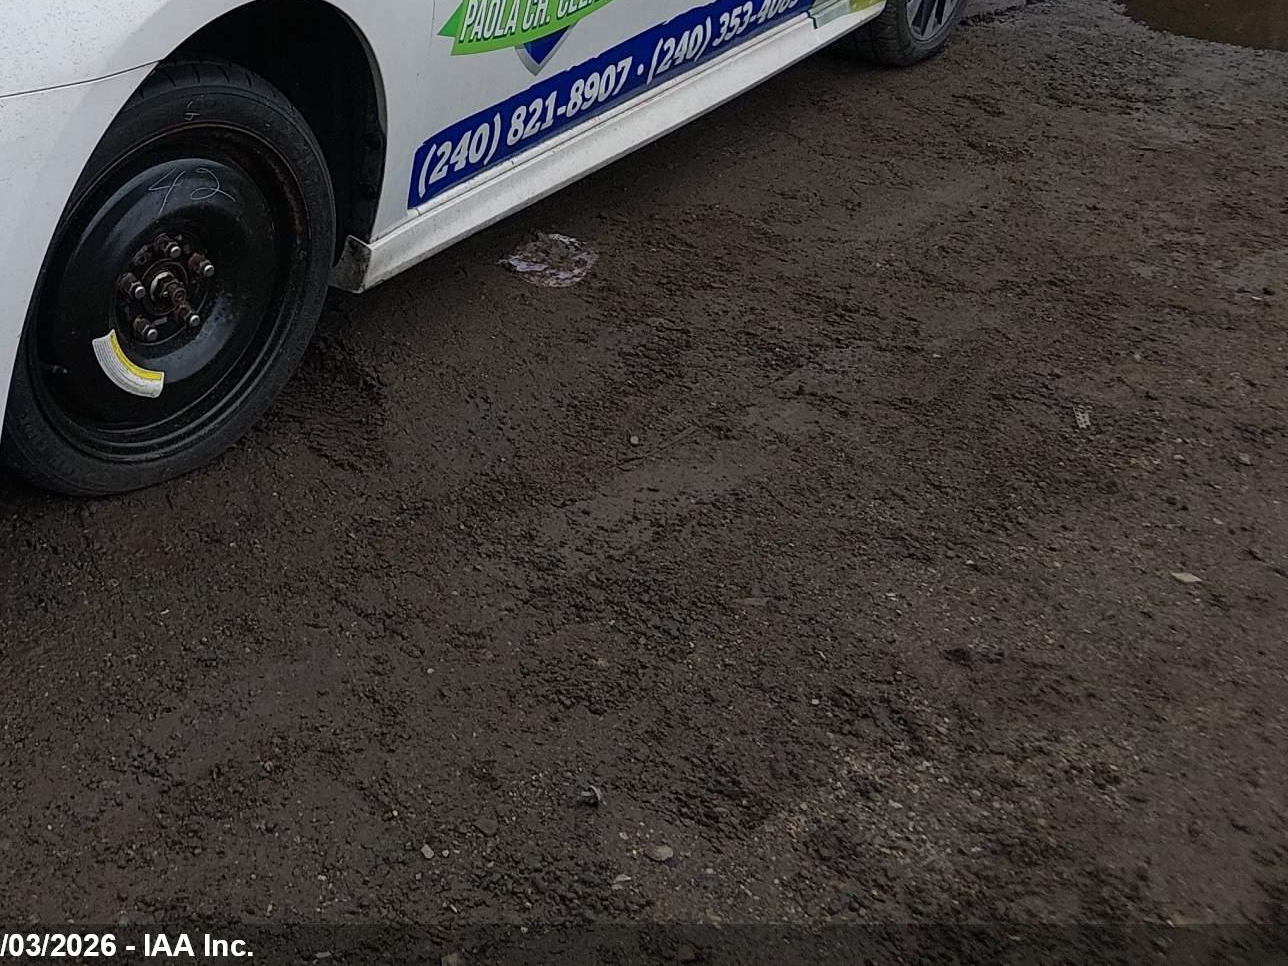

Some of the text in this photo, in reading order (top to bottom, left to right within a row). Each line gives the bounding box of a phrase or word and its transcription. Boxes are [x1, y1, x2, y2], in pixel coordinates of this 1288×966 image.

[417, 112, 501, 198] (240)
[506, 56, 632, 146] 821-8907
[647, 16, 712, 86] (240)
